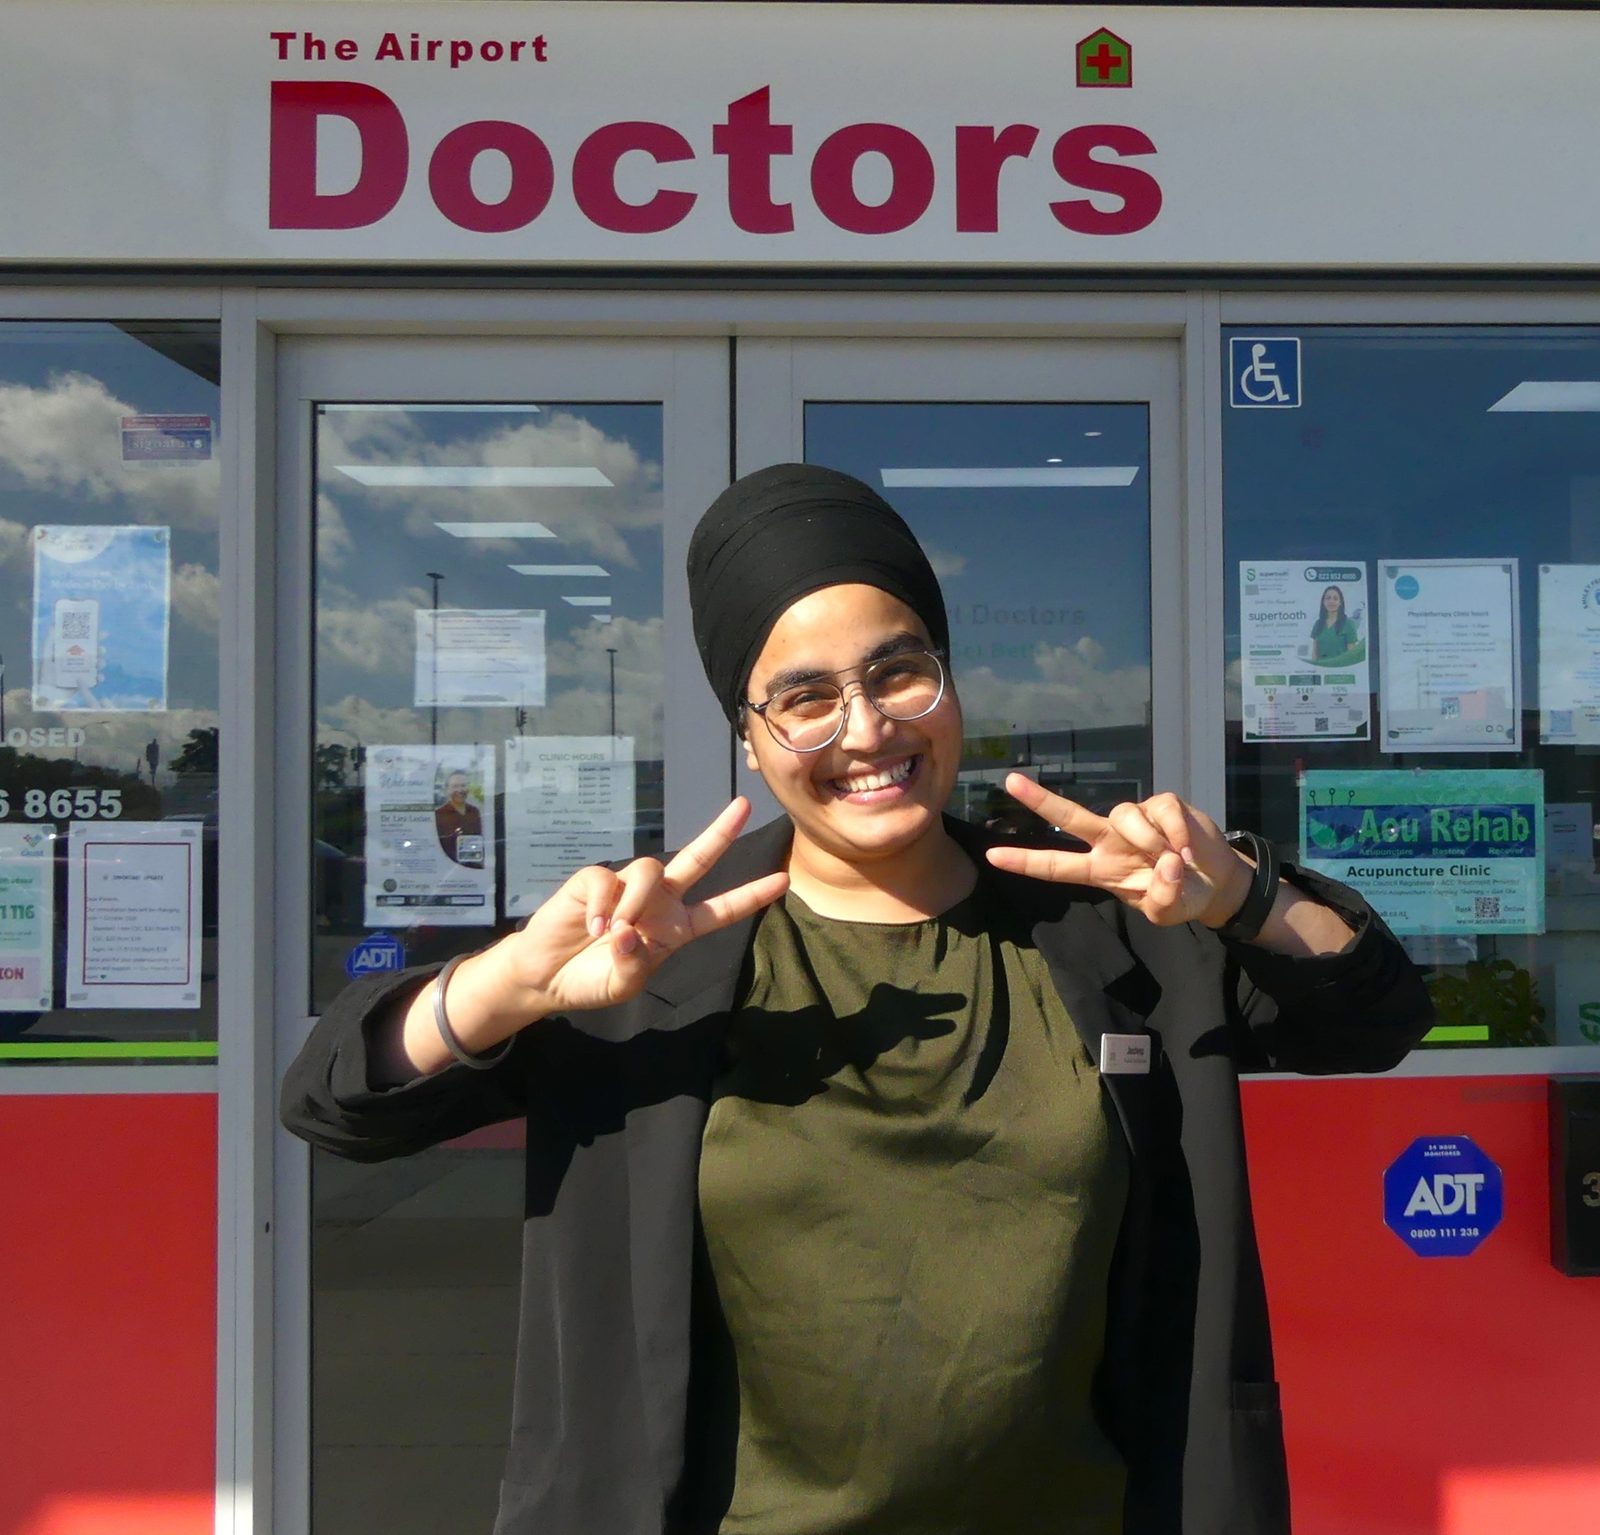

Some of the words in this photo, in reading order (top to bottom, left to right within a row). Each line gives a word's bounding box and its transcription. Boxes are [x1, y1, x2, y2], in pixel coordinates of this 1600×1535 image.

[270, 32, 359, 61] The
[375, 32, 548, 68] Airport
[268, 81, 1162, 235] Doctors
[972, 604, 1085, 625] Doctors
[1248, 610, 1306, 622] supertooth
[539, 753, 570, 761] CLINIC
[572, 753, 604, 761] HOURS
[24, 789, 123, 819] 8655
[1358, 808, 1419, 843] Acu
[1431, 808, 1530, 843] Rehab
[1359, 848, 1414, 856] Acupuncture
[1347, 865, 1444, 879] Acupuncture
[1450, 864, 1491, 877] Clinic
[10, 905, 36, 919] 116
[355, 948, 395, 968] ADT
[1403, 1173, 1485, 1217] ADT
[1410, 1228, 1437, 1238] 0800
[1440, 1228, 1456, 1237] 111
[1460, 1227, 1479, 1237] 238
